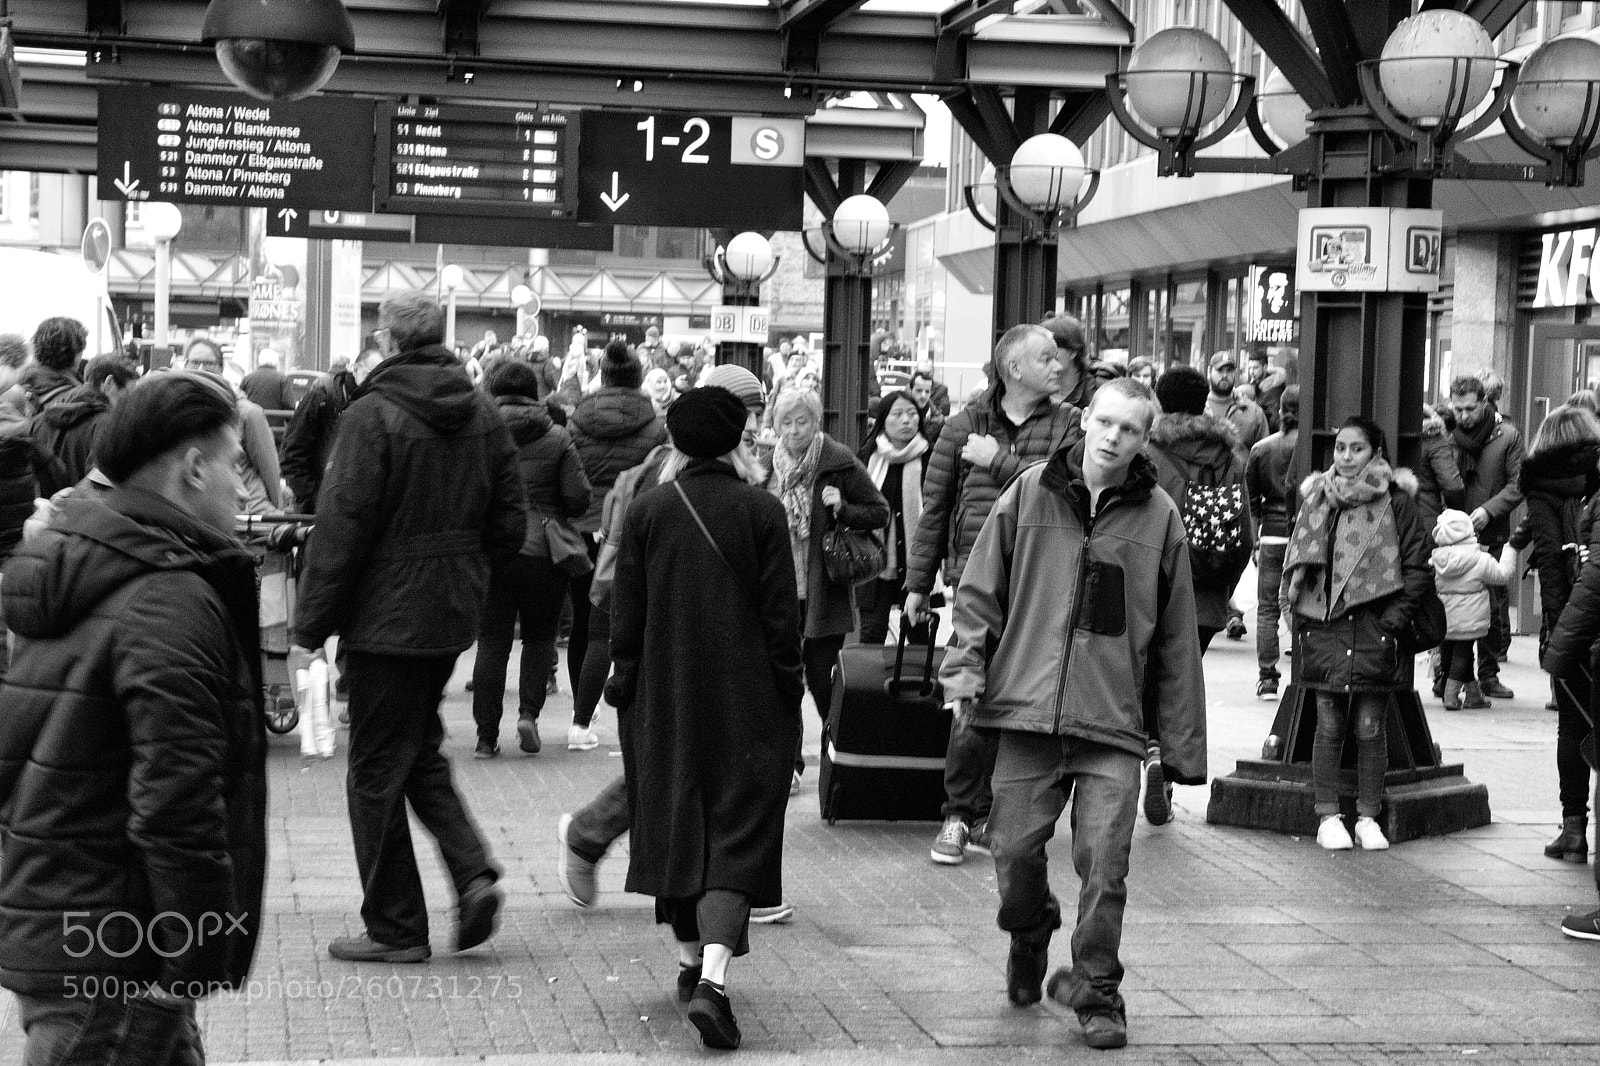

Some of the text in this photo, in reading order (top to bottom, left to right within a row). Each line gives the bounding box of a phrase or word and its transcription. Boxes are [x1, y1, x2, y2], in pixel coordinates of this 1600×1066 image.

[186, 103, 224, 119] Altona
[234, 105, 270, 121] Wedel
[186, 119, 224, 134] Altona
[234, 121, 300, 138] Blankenese
[415, 124, 442, 137] Wedel
[524, 129, 531, 141] 1
[185, 135, 264, 154] Jungfernstieg
[274, 139, 311, 154] Altona
[636, 115, 711, 164] 1-2
[415, 144, 447, 157] Altona
[185, 150, 239, 166] Dammtor
[248, 153, 323, 170] Elbgaustraße
[185, 166, 223, 180] Altona
[233, 168, 291, 187] Pinneberg
[184, 181, 238, 197] Dammtor
[247, 184, 285, 199] Altona
[414, 182, 461, 199] Pinneberg
[523, 187, 529, 200] 1
[714, 313, 732, 330] DB
